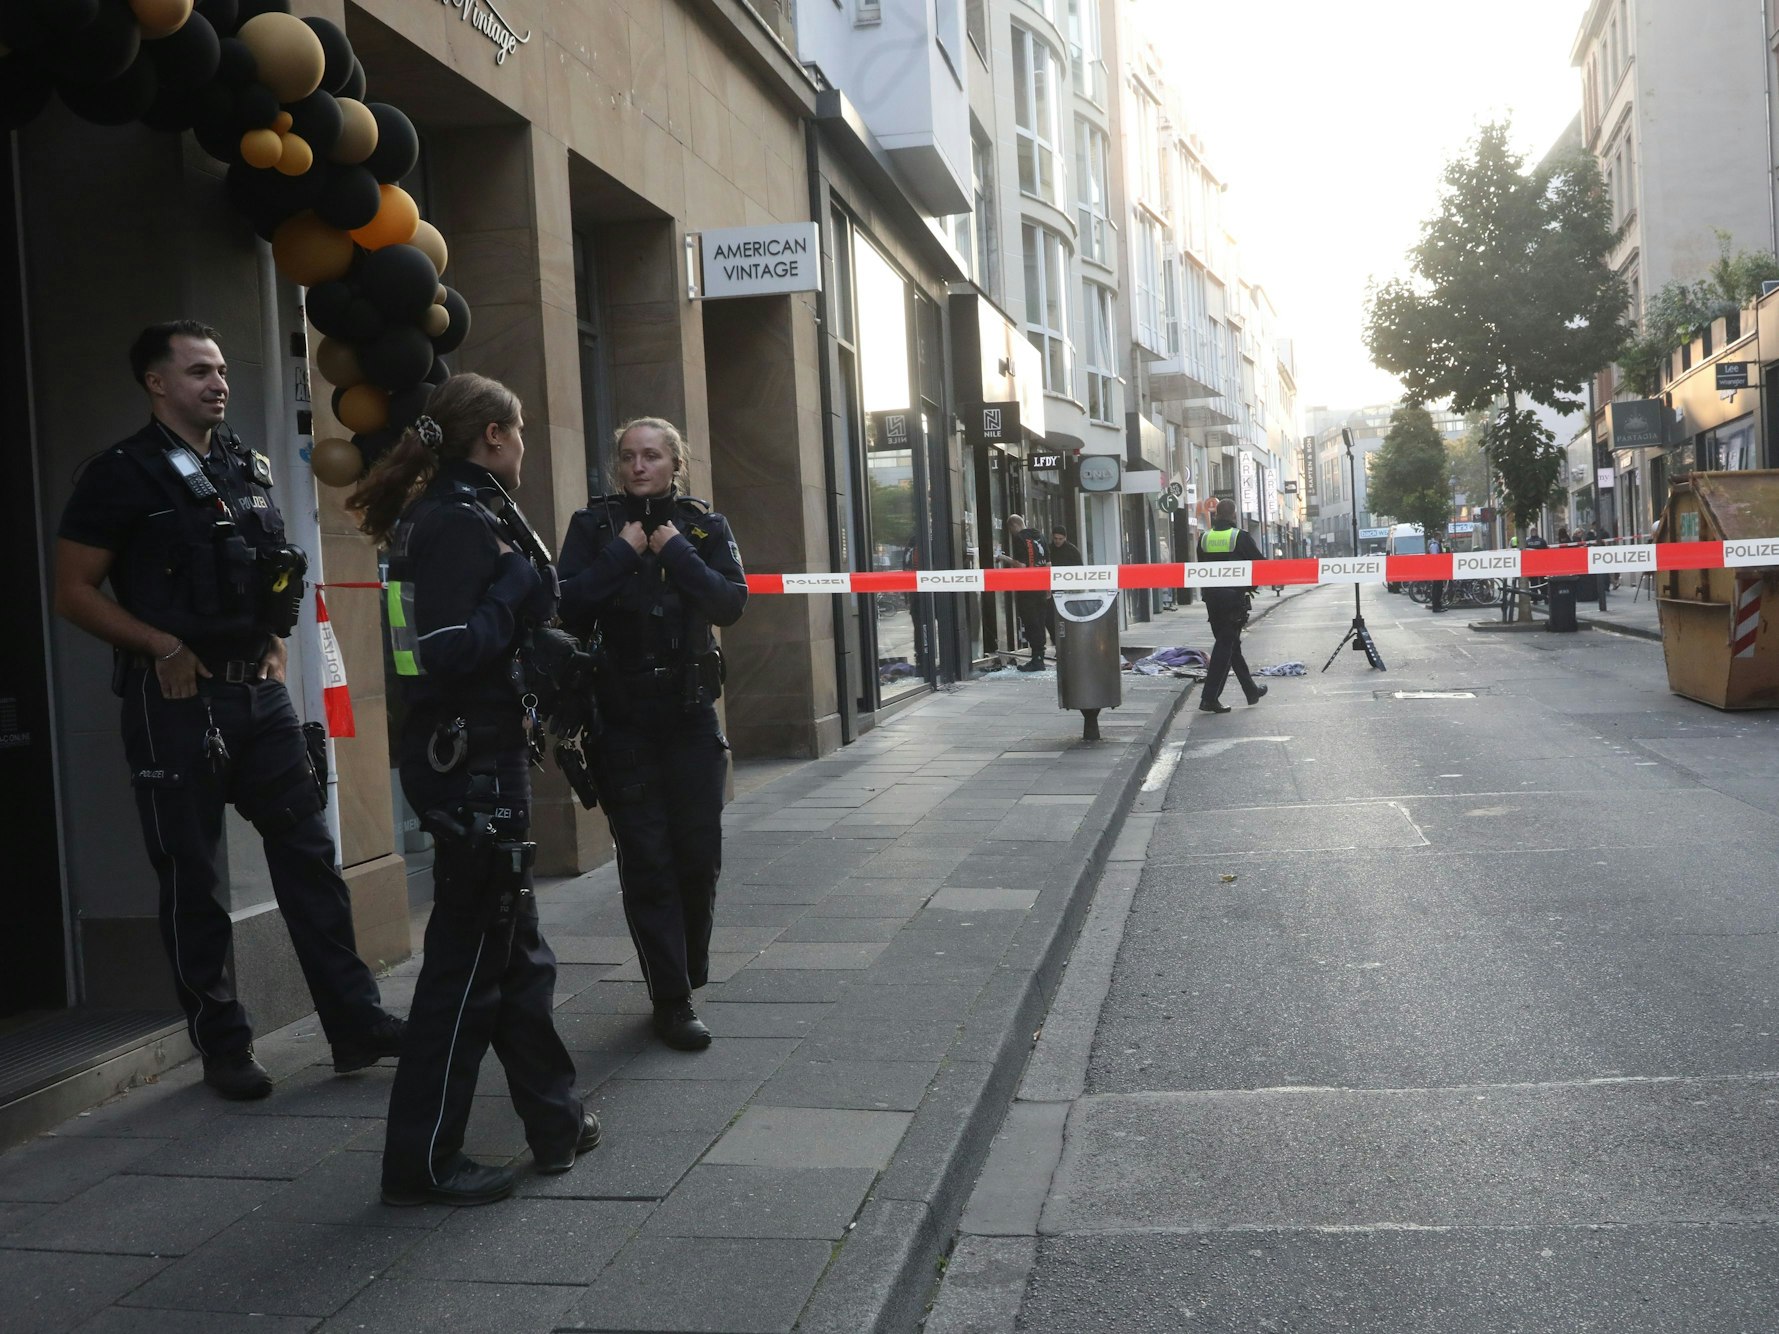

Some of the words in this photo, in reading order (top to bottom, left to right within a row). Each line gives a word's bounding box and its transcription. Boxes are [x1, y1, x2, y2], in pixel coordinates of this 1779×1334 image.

[714, 238, 808, 260] AMERICAN
[723, 261, 799, 281] VINTAGE
[1724, 365, 1740, 374] Lee
[983, 430, 1002, 438] NILE
[1034, 456, 1058, 467] LFDY
[1242, 453, 1251, 511] ARKET
[1267, 470, 1277, 521] ARKET
[238, 496, 268, 511] POLIZEI
[1457, 557, 1517, 570] POLIZEI
[1592, 551, 1651, 564] POLIZEI
[1187, 567, 1246, 578] POLIZEI
[1321, 562, 1380, 575] POLIZEI
[920, 576, 979, 584] POLIZEI
[1052, 571, 1112, 581] POLIZEI
